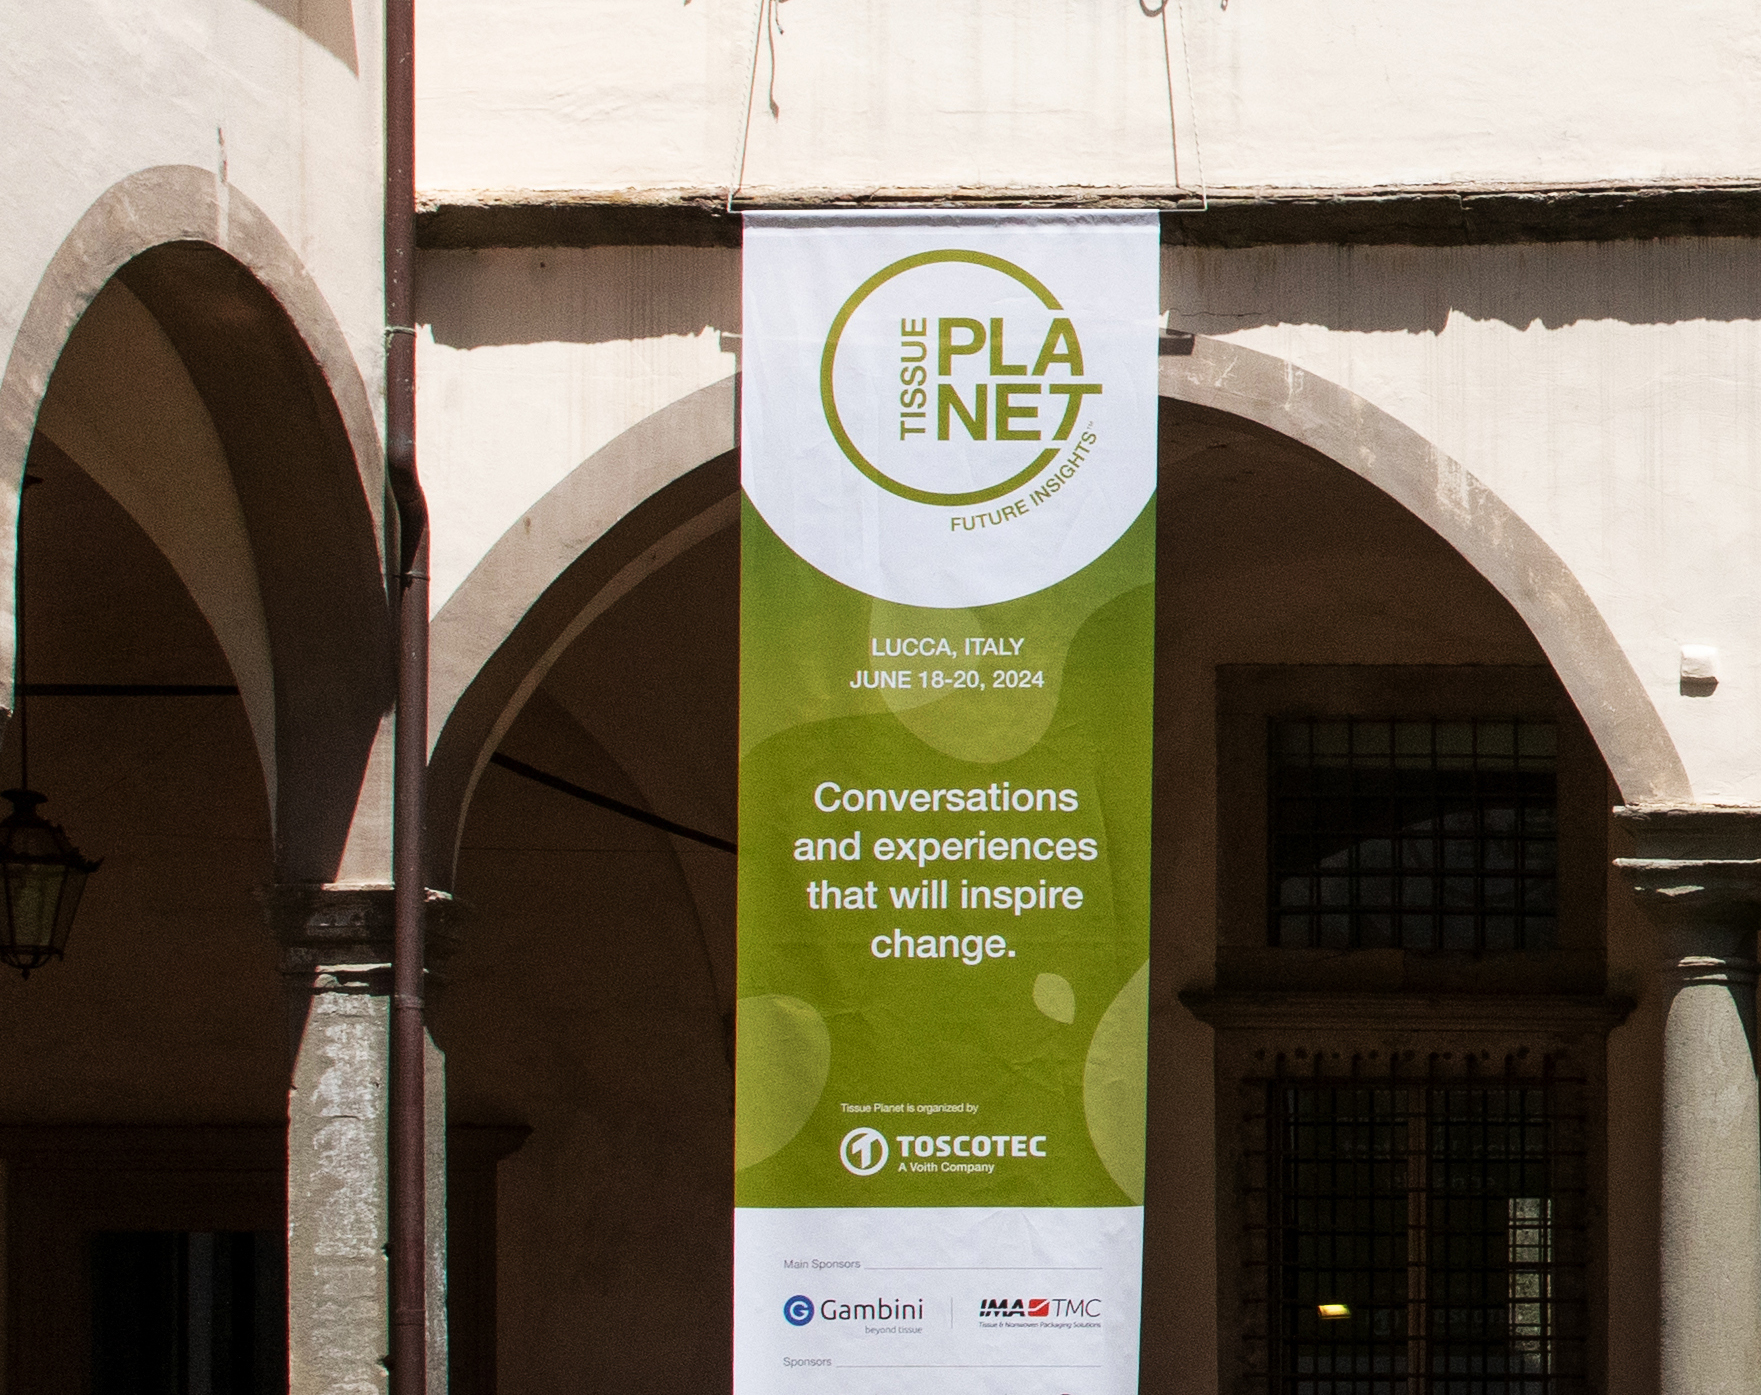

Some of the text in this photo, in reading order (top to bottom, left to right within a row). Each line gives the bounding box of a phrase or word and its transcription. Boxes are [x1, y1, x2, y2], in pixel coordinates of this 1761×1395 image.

[937, 317, 1084, 376] PLA
[900, 317, 927, 440] TISSUE
[937, 383, 1103, 441] NET
[951, 499, 1030, 532] FUTURE
[872, 638, 1025, 658] LUCCA, ITALY
[850, 670, 1044, 691] JUNE 18-20, 2024
[813, 781, 1079, 812] Conversations
[794, 832, 1098, 867] and experiences
[807, 880, 1083, 916] that will inspire
[870, 928, 1016, 965] change.
[840, 1103, 979, 1115] Tissue Planet is organized by
[896, 1135, 1047, 1157] TOSCOTEC
[898, 1162, 995, 1174] A Voith Company
[783, 1259, 861, 1271] Main Sponsors
[820, 1297, 923, 1320] Gambini
[979, 1299, 1102, 1317] IMA TMC
[864, 1326, 923, 1335] beyond tissue
[783, 1357, 832, 1368] Sponsors
